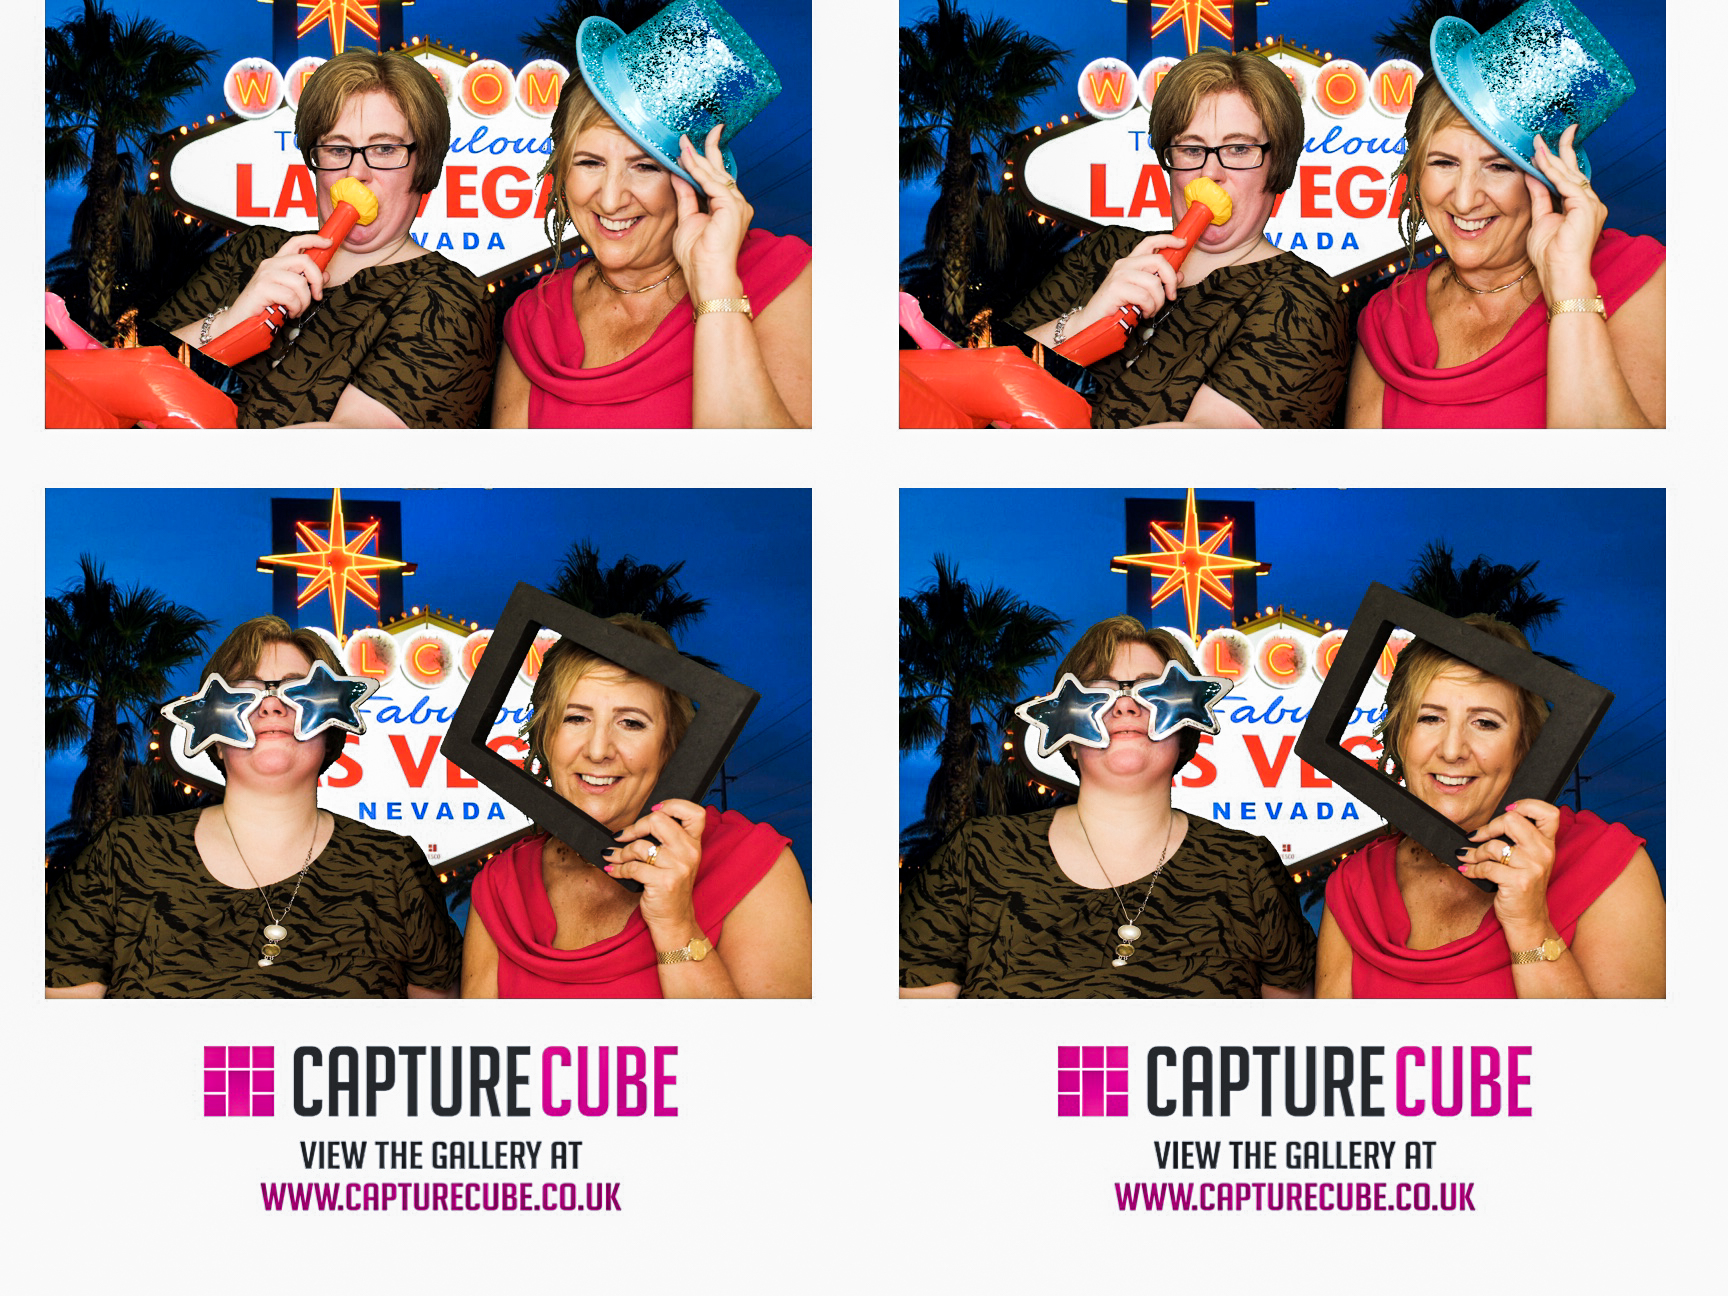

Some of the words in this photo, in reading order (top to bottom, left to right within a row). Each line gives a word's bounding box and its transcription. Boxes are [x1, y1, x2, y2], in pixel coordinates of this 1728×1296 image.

[236, 163, 319, 219] LA
[1090, 163, 1173, 219] LA
[410, 232, 506, 250] VADA
[1264, 232, 1360, 250] VADA
[358, 802, 506, 821] NEVADA
[1212, 802, 1360, 821] NEVADA
